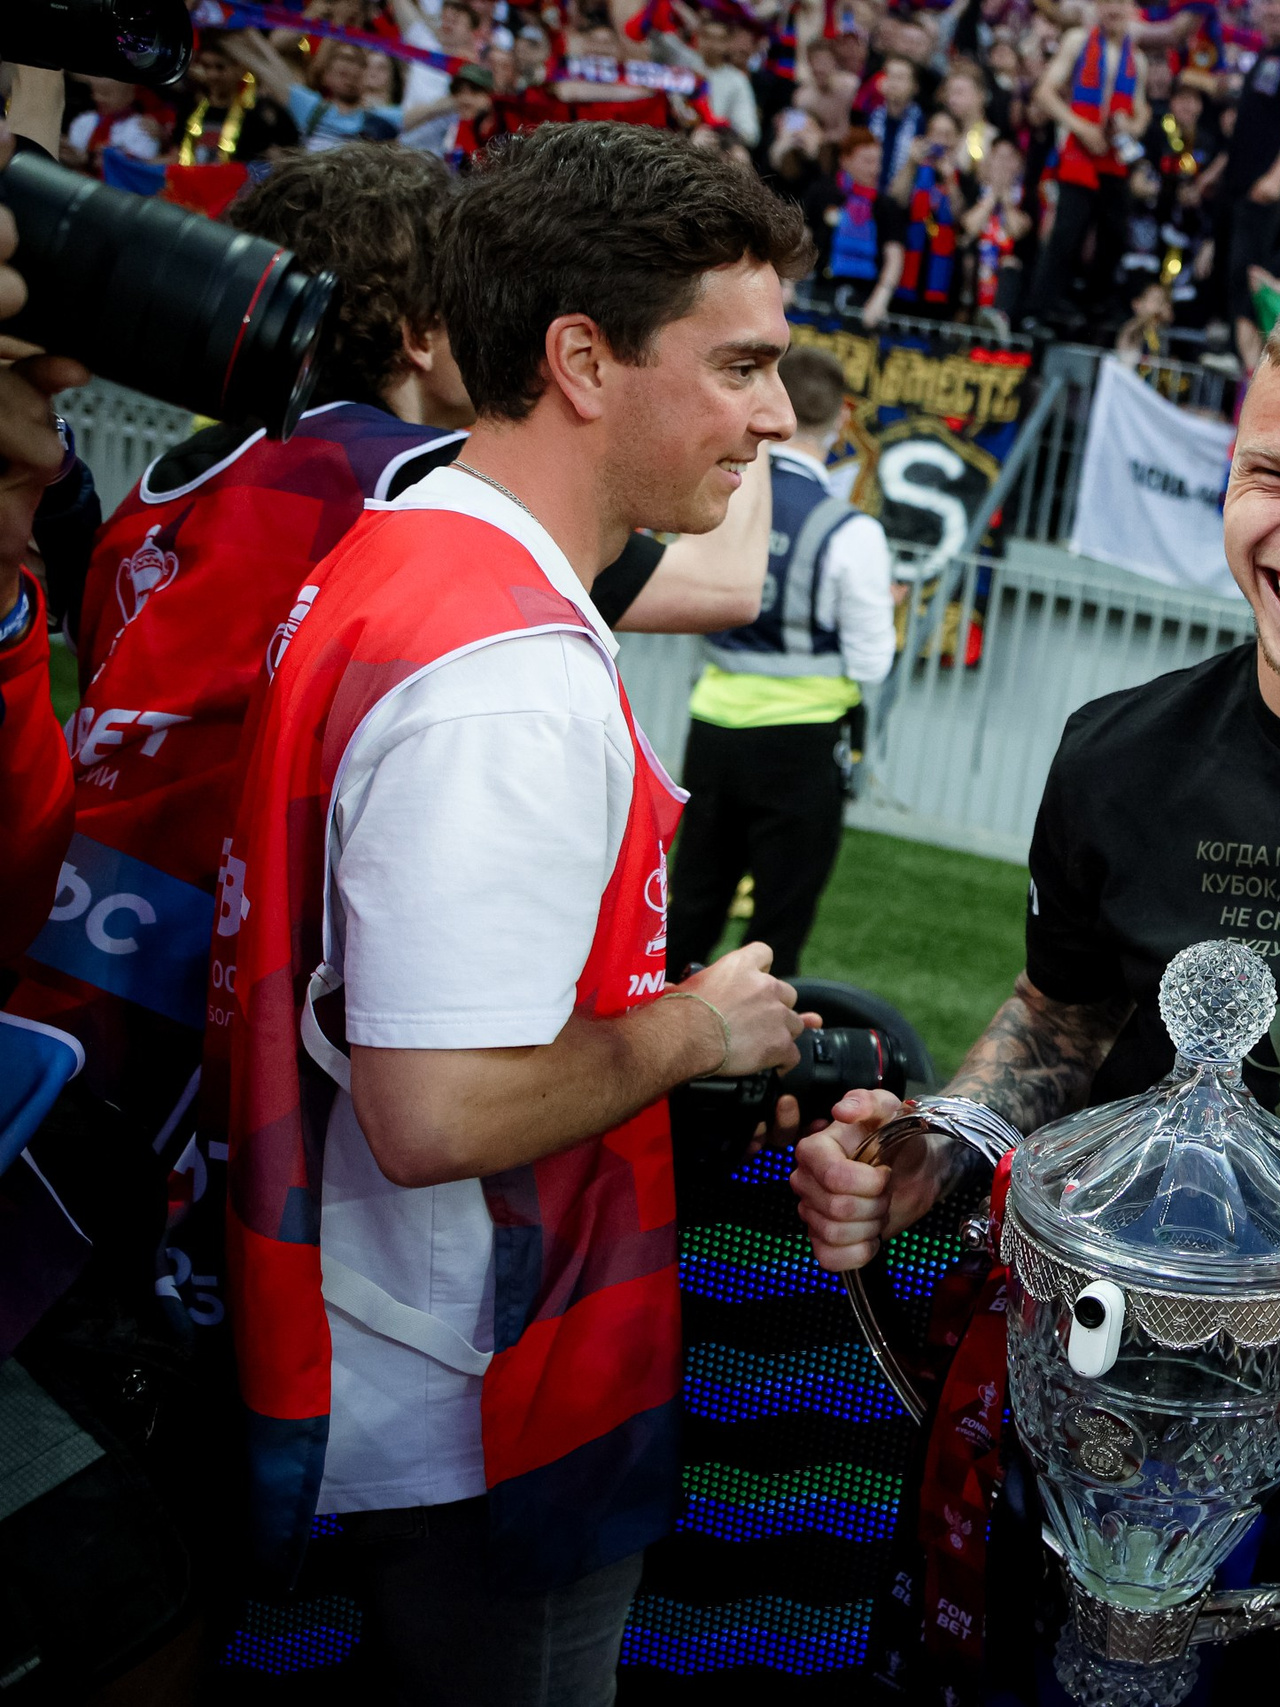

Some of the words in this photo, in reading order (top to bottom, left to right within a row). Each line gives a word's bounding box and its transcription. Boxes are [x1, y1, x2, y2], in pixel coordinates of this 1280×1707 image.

[1196, 840, 1270, 870] КОГДА
[1219, 905, 1251, 928] НЕ
[936, 1612, 972, 1640] BET
[937, 1597, 973, 1628] FON
